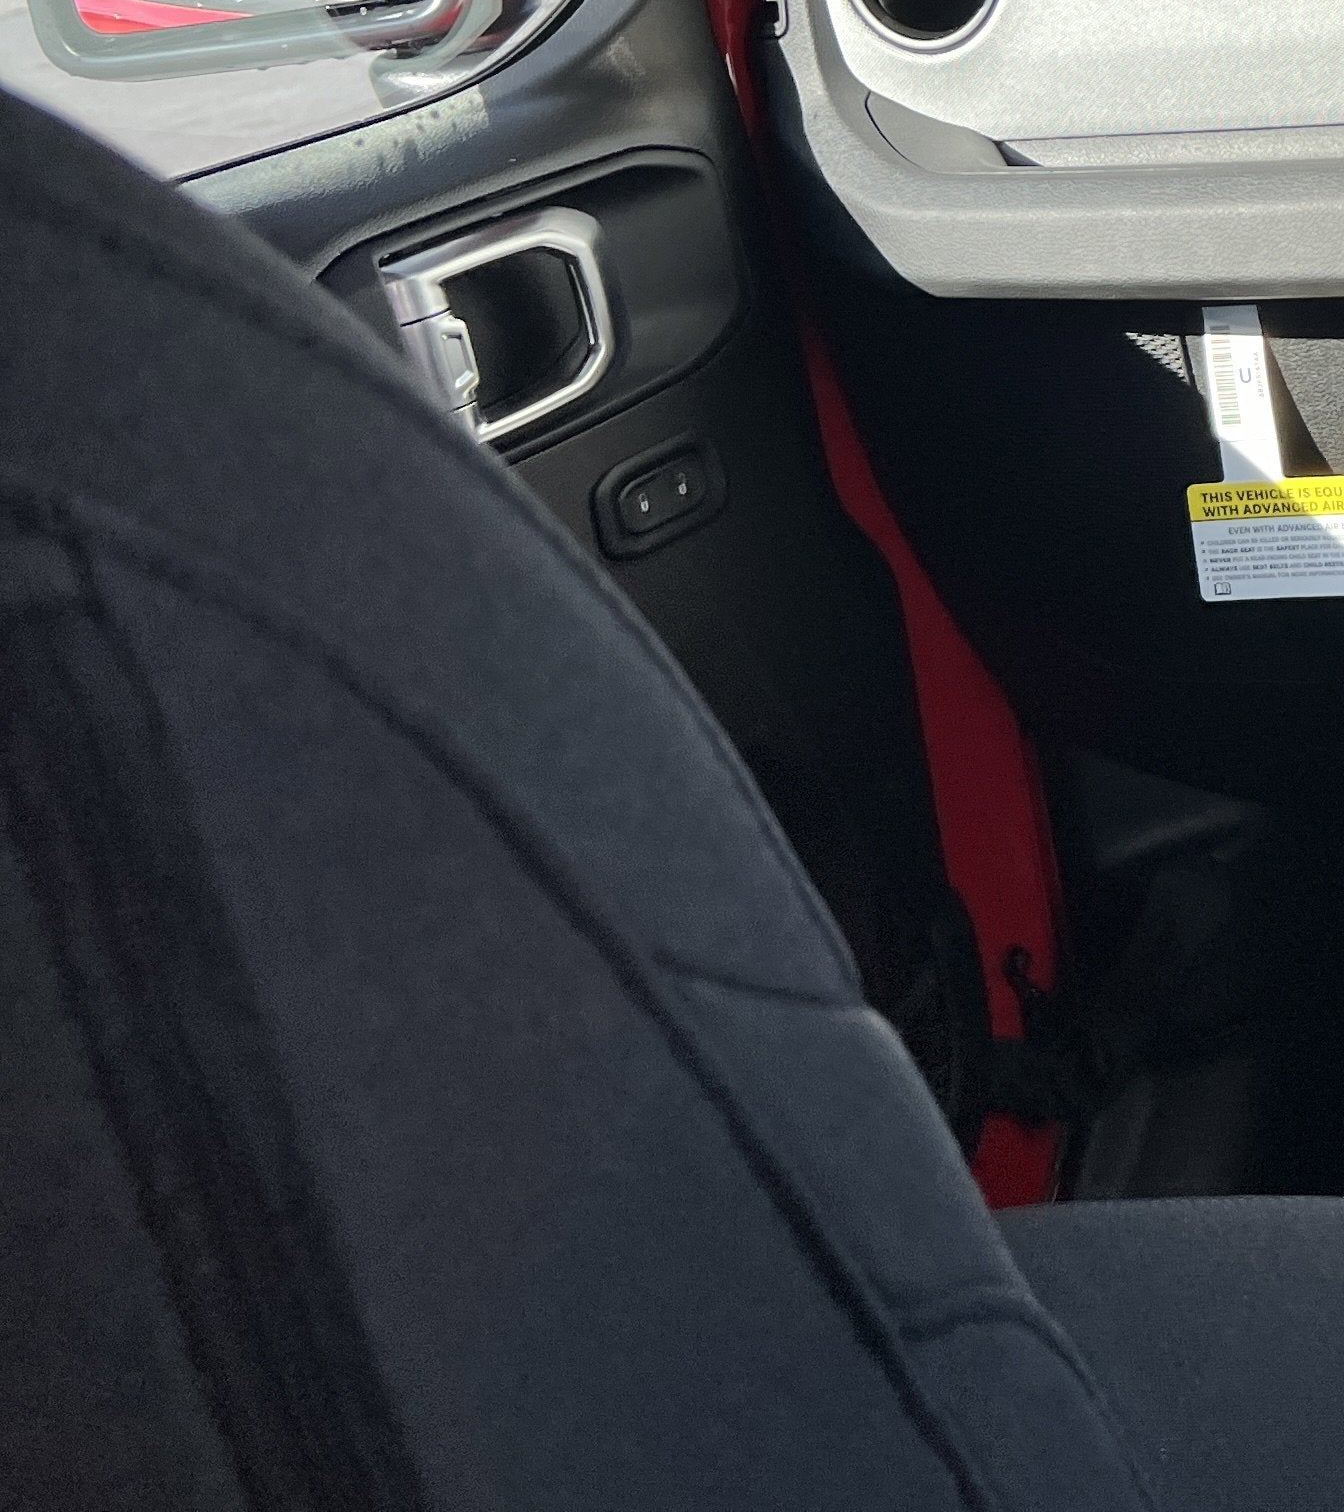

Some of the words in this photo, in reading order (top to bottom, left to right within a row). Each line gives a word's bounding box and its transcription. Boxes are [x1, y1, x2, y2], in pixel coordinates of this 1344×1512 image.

[1202, 492, 1233, 504] THIS
[1236, 488, 1295, 501] VEHICLE
[1298, 487, 1311, 498] IS
[1202, 504, 1240, 517] WITH
[1243, 501, 1318, 515] ADVANCED
[1228, 526, 1251, 535] EVEN
[1252, 524, 1276, 534] WITH
[1277, 523, 1322, 532] ADVANCED
[1324, 522, 1340, 530] AIR
